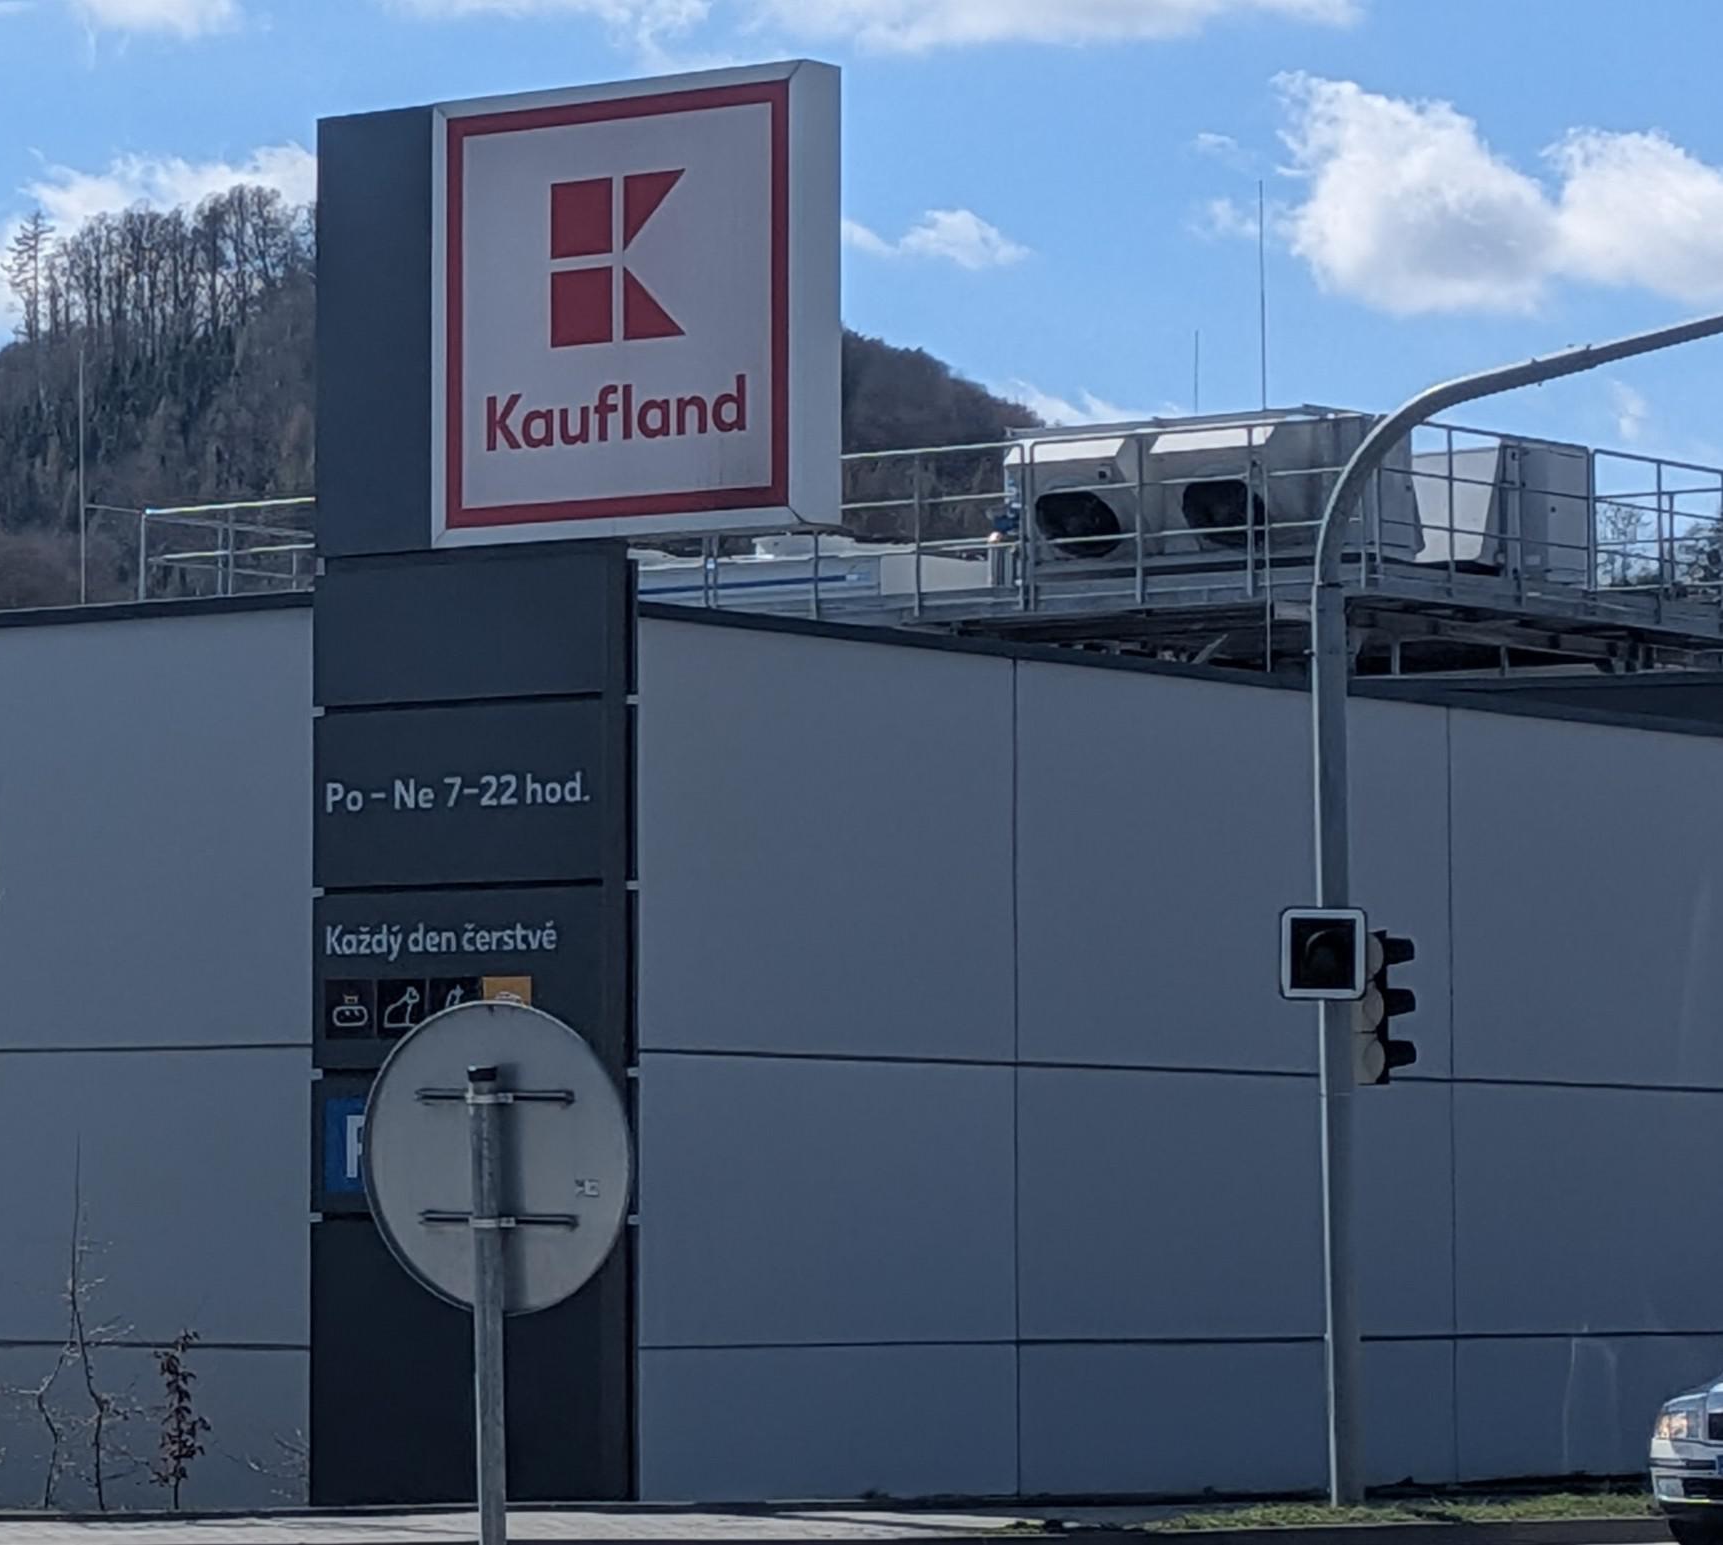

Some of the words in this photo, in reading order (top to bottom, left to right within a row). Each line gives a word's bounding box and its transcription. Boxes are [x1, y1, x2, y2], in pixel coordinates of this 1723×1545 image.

[486, 373, 746, 451] Kaufland
[325, 782, 364, 813] Po
[394, 778, 435, 809] Ne
[525, 771, 590, 804] hod.
[326, 923, 403, 962] Každý
[407, 922, 457, 952] den
[461, 920, 557, 952] čerstvé
